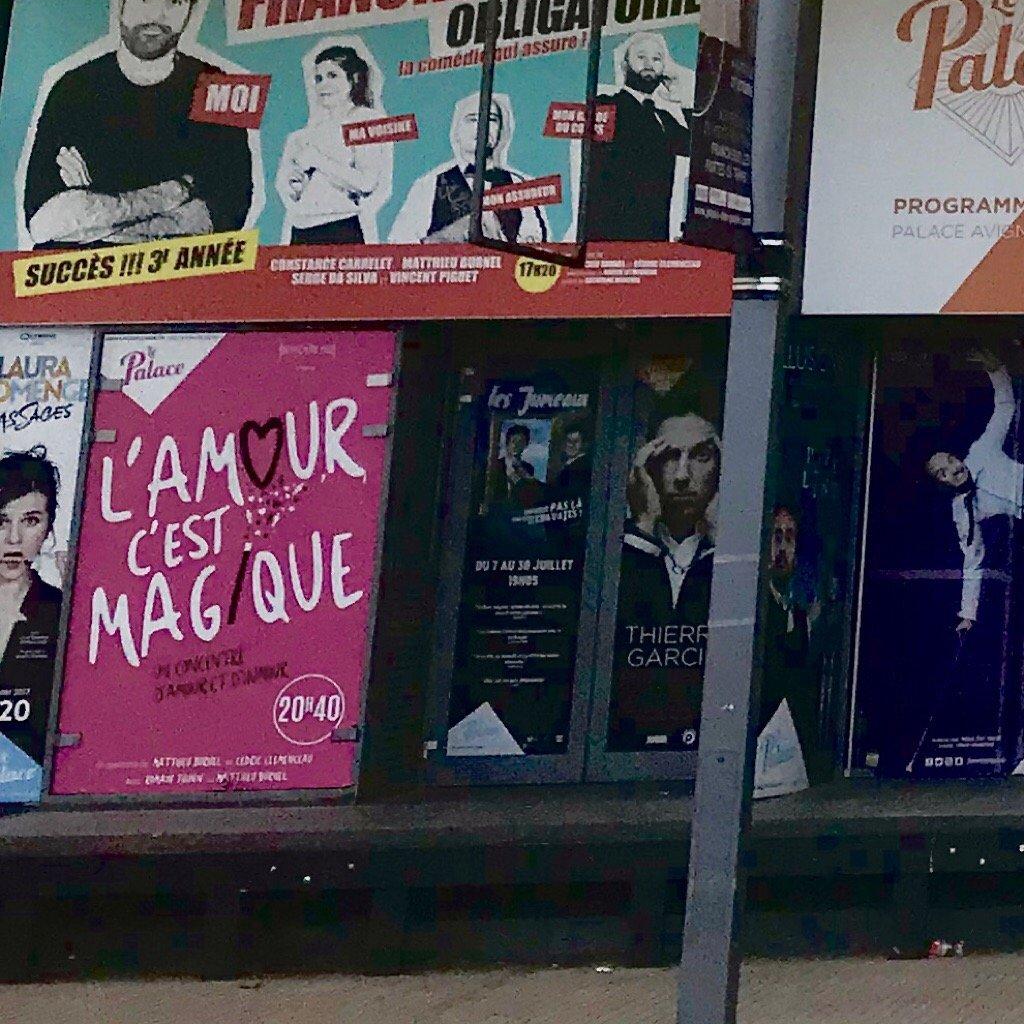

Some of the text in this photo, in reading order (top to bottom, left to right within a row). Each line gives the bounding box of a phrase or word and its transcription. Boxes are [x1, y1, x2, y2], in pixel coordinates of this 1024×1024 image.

[205, 84, 260, 113] MOI
[892, 223, 964, 239] PALACE
[25, 252, 115, 287] SUCCÈS
[174, 238, 247, 270] ANNÉE
[119, 350, 185, 386] Palace
[127, 504, 231, 577] C'EST
